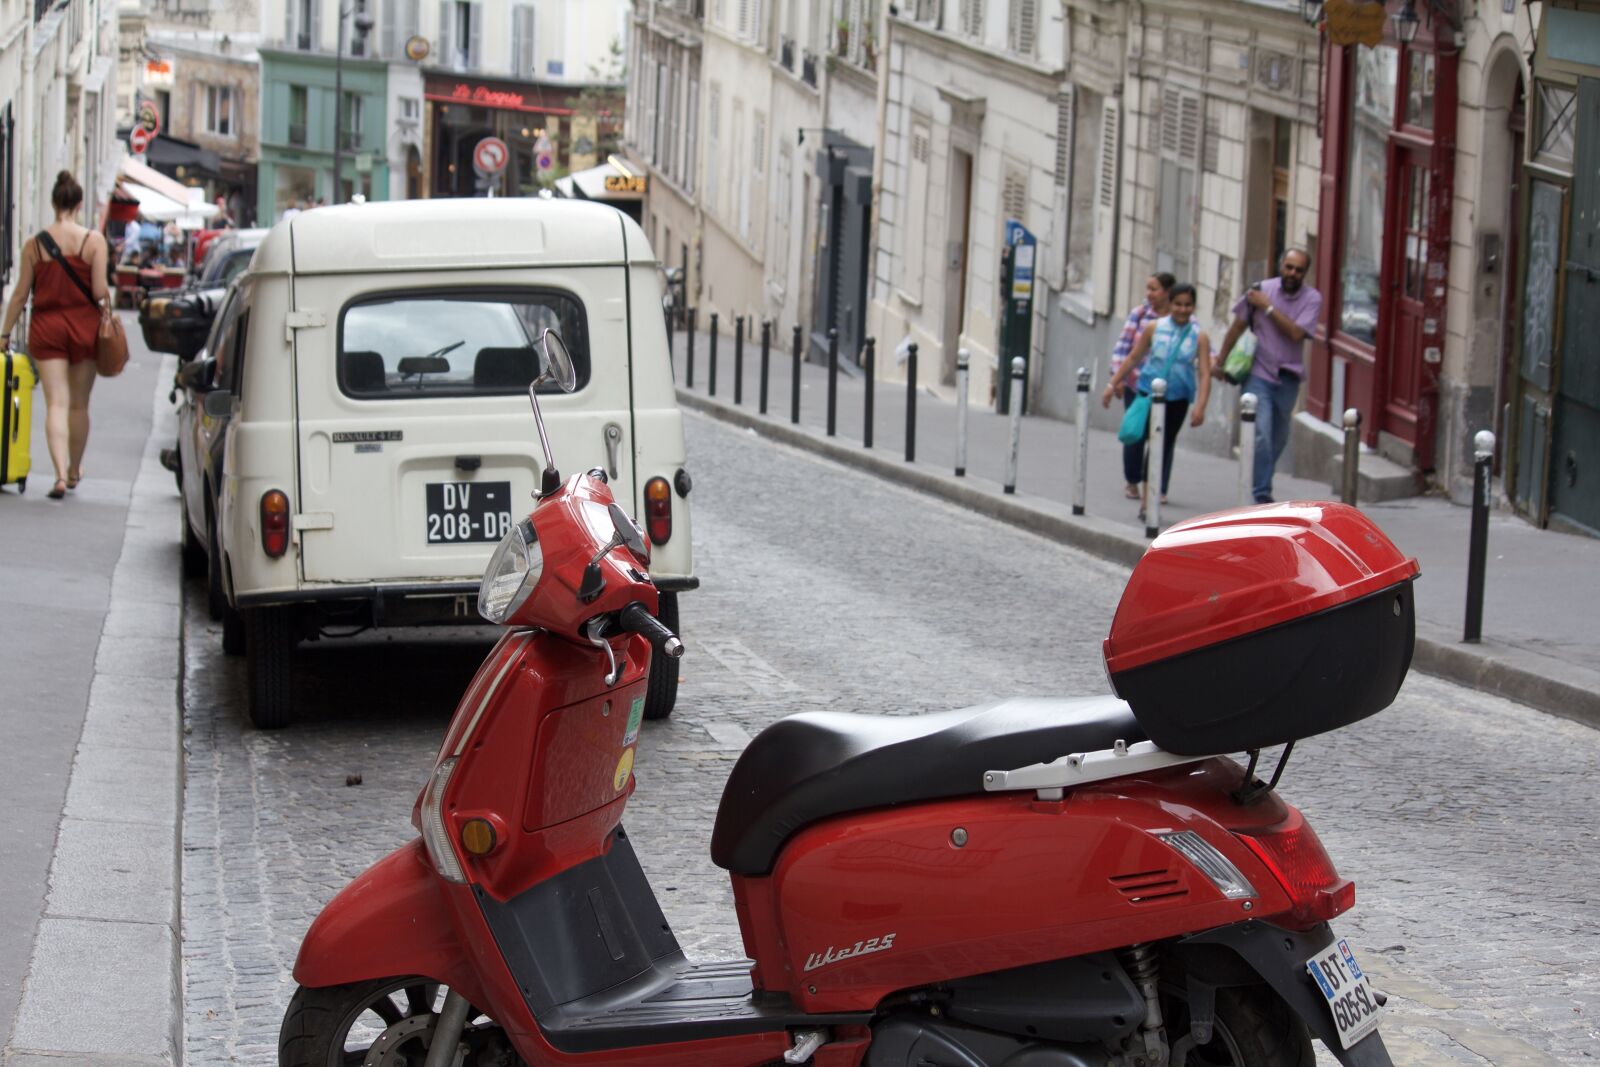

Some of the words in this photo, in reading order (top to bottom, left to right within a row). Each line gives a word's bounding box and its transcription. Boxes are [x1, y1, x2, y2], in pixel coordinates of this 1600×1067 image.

[1013, 229, 1024, 244] P
[334, 433, 376, 442] RENAULT
[443, 484, 470, 510] DV
